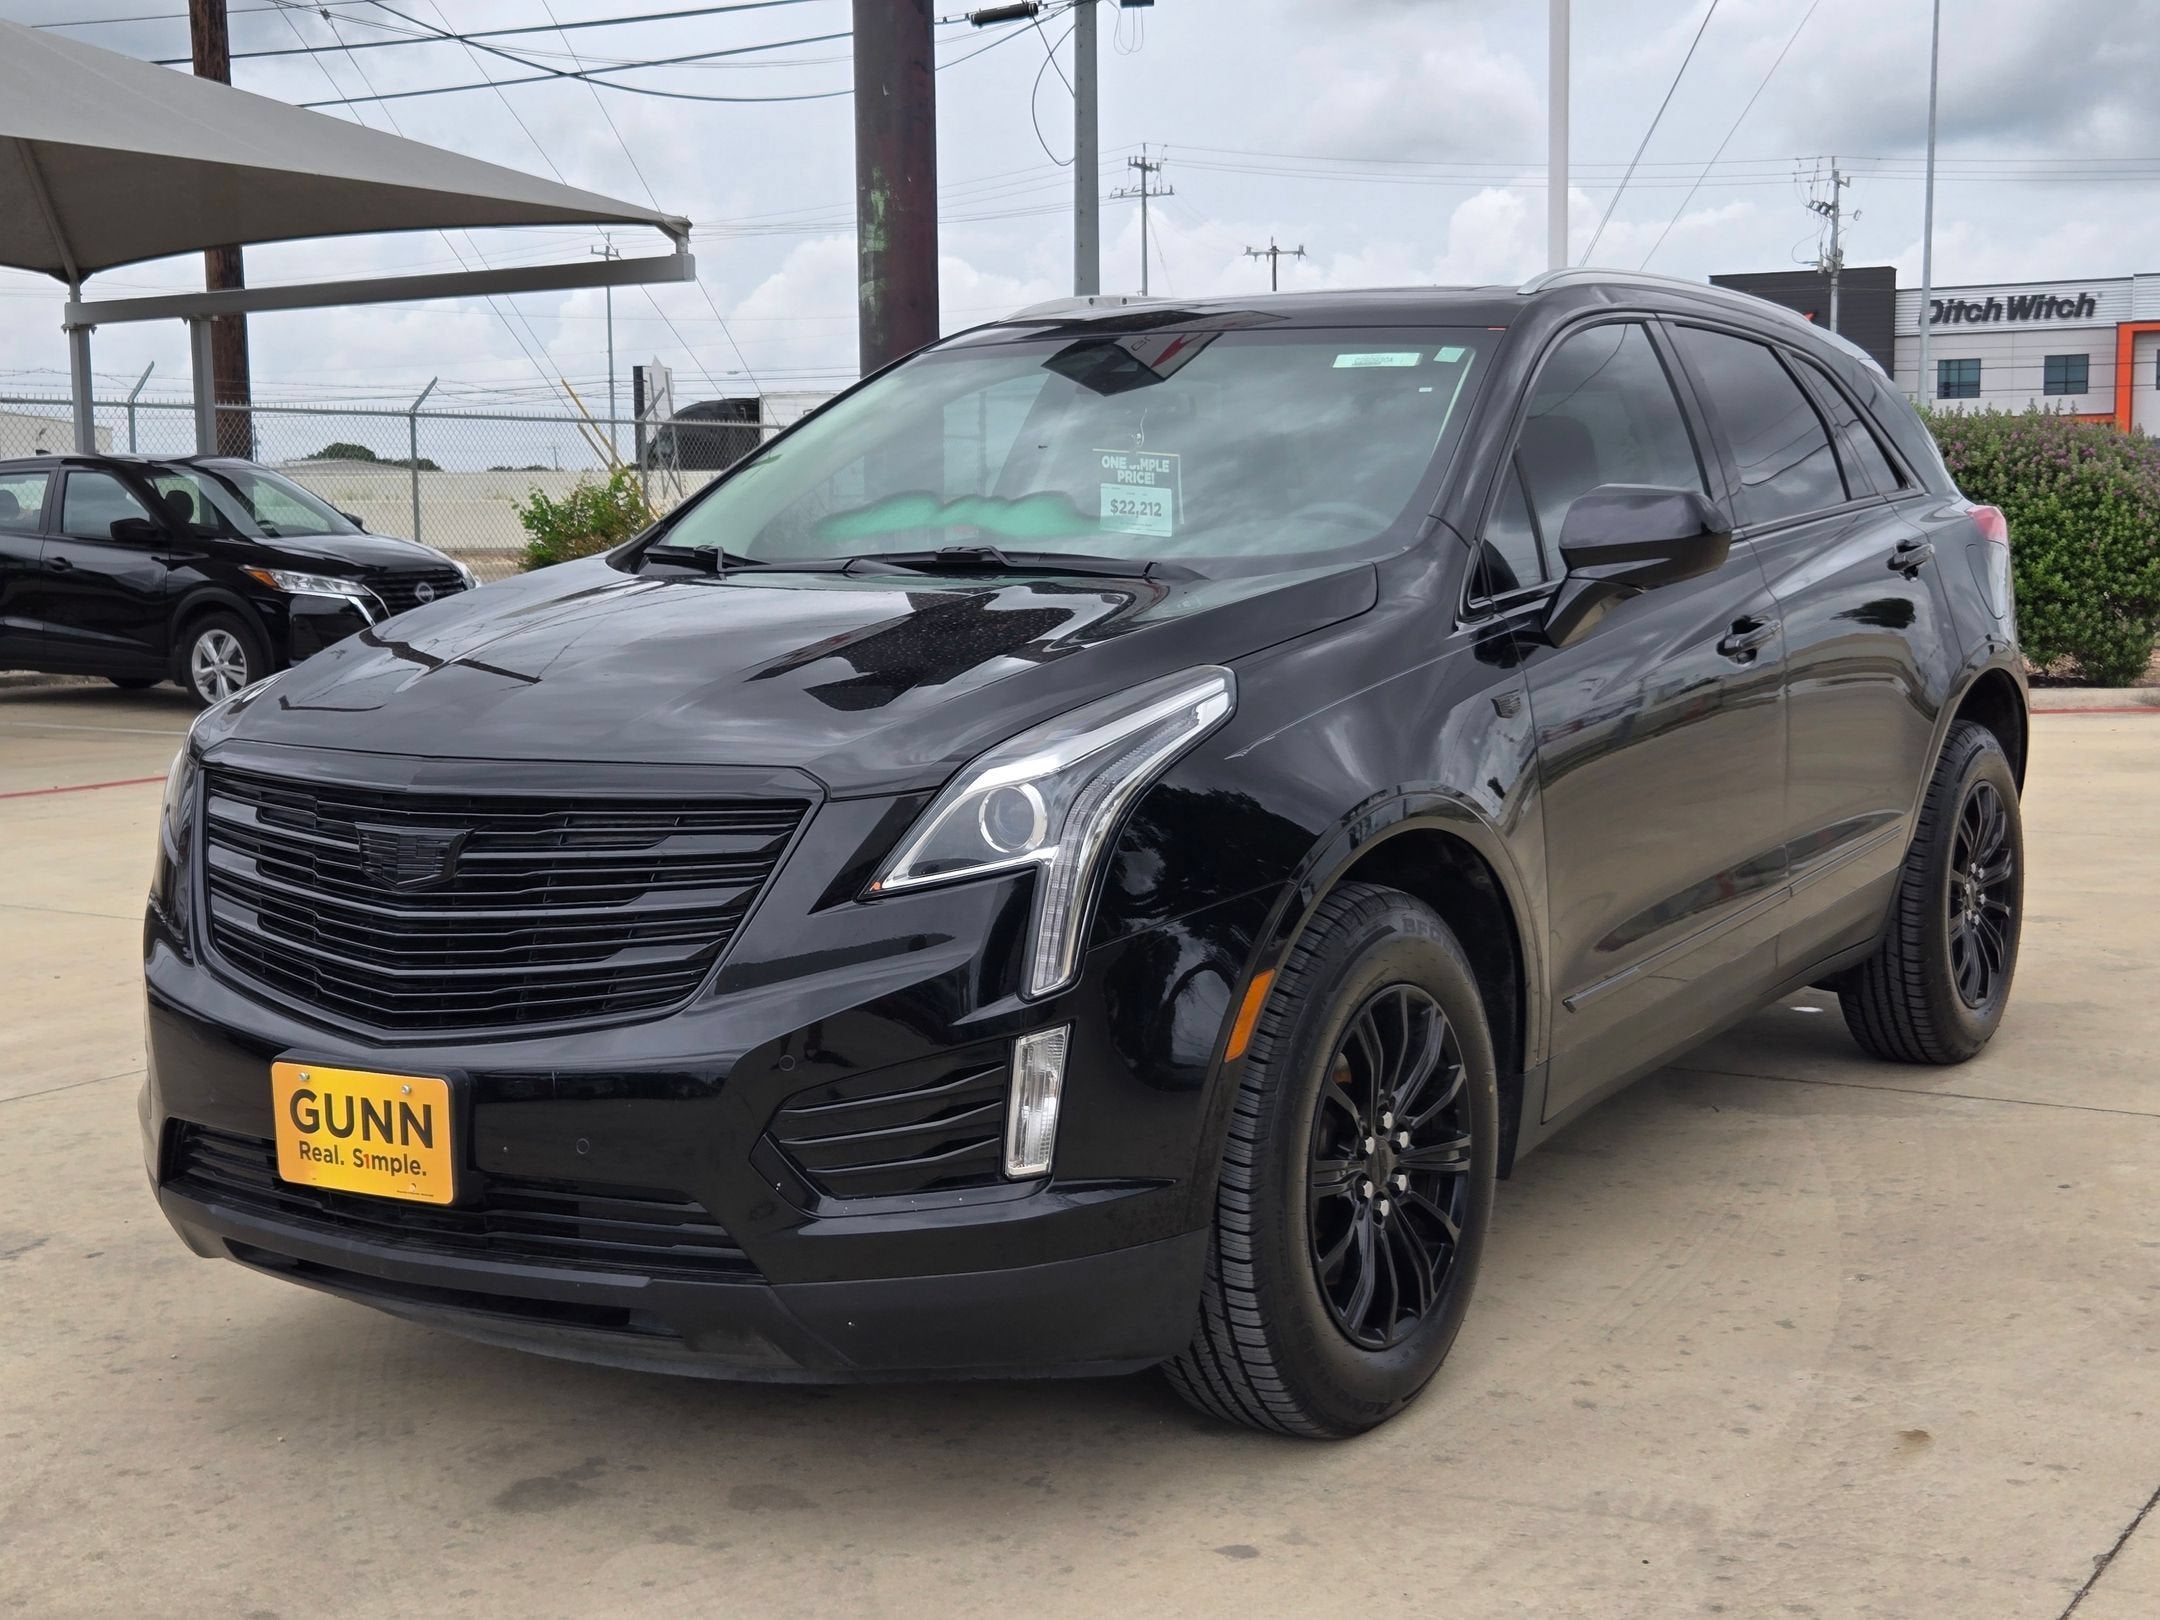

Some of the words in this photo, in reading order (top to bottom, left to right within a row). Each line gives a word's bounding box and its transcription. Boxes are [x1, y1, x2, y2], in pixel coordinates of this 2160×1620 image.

[1919, 297, 2002, 326] Ditch
[2006, 292, 2096, 321] Witch
[1101, 456, 1128, 469] ONE
[1129, 458, 1170, 473] MPLE
[1117, 470, 1155, 485] PRICE!
[1110, 499, 1162, 518] $22,212
[290, 1088, 434, 1149] GUNN
[299, 1140, 345, 1166] Real.
